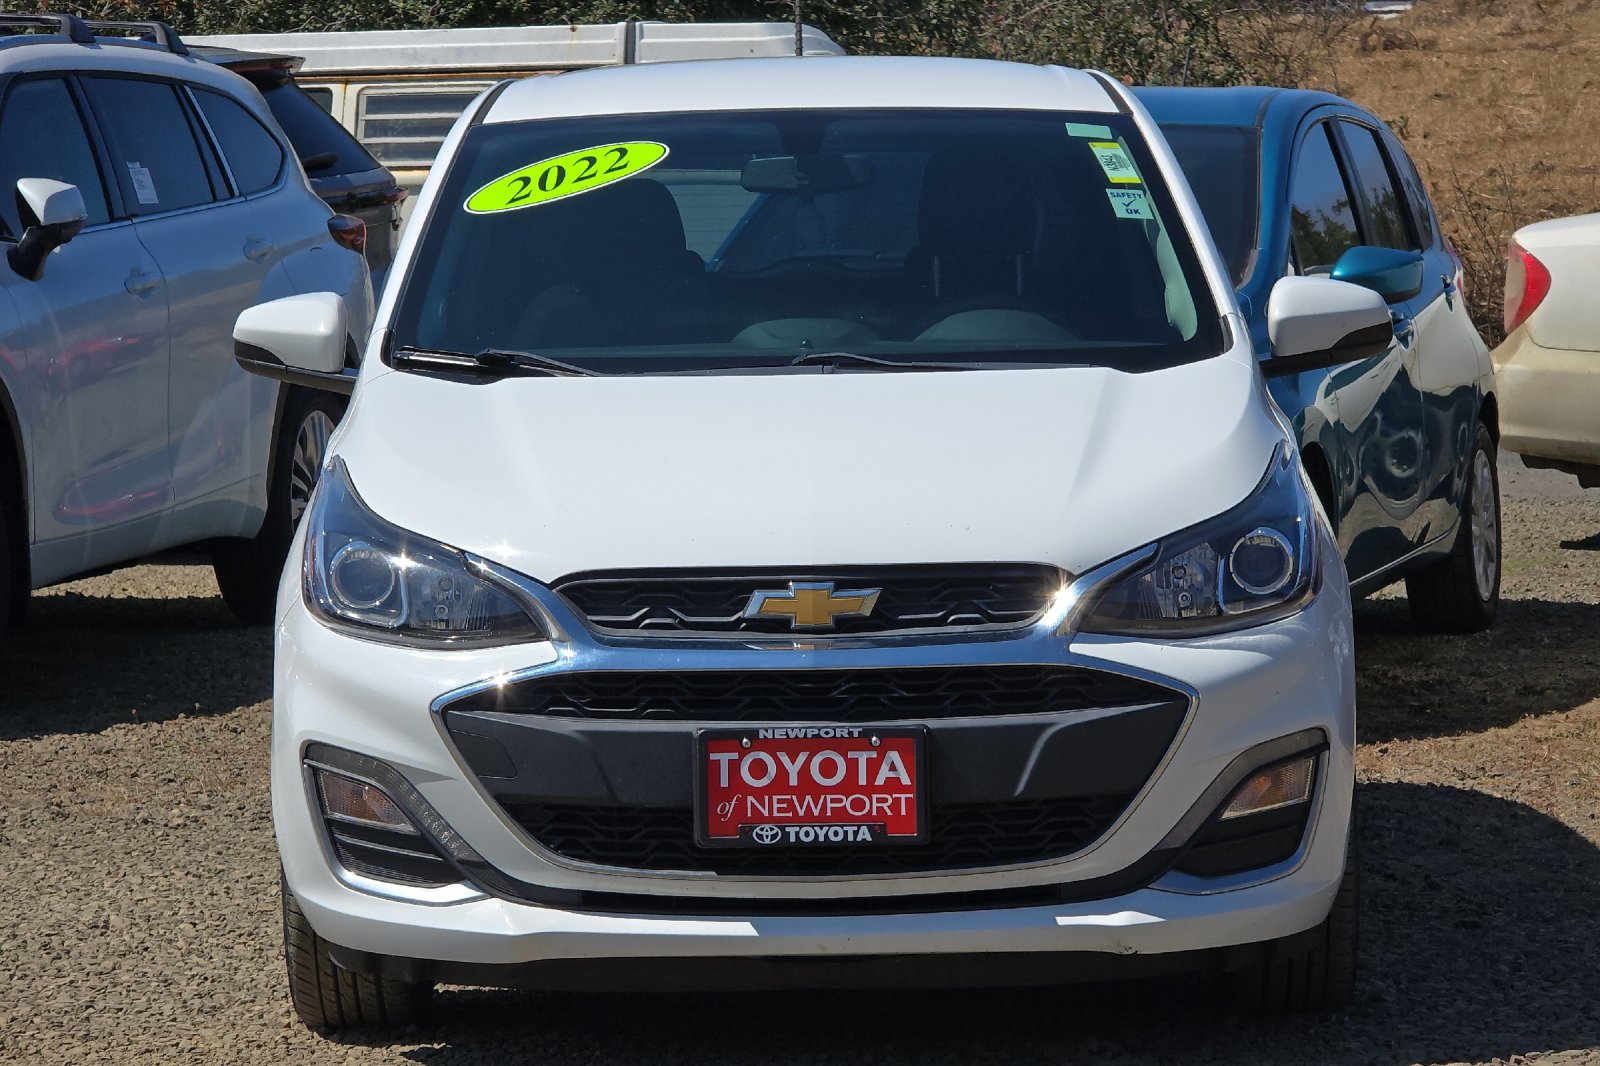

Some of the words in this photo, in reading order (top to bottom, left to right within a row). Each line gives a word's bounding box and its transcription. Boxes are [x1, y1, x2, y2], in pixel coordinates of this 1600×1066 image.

[506, 147, 630, 205] 2022
[1109, 191, 1142, 199] SAFETY
[758, 727, 863, 739] NEWPORT
[710, 750, 912, 788] TOYOTA
[717, 793, 742, 822] of
[746, 793, 914, 817] NEWPORT
[785, 825, 873, 842] TOYOTA
